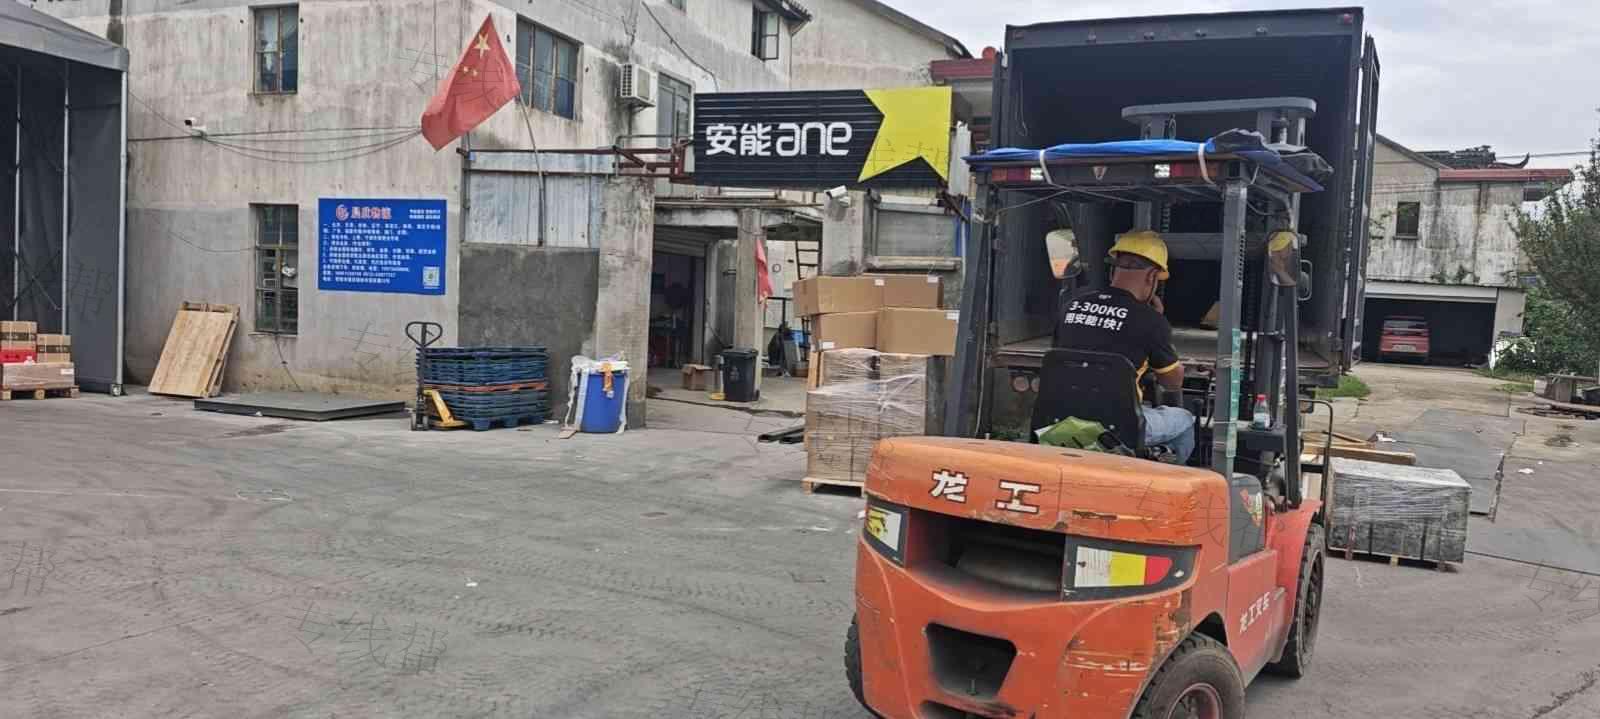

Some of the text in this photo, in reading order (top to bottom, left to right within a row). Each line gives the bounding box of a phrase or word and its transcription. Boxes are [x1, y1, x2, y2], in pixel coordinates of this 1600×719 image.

[705, 121, 853, 157] 安能 ane
[1068, 300, 1129, 319] 3-300KG
